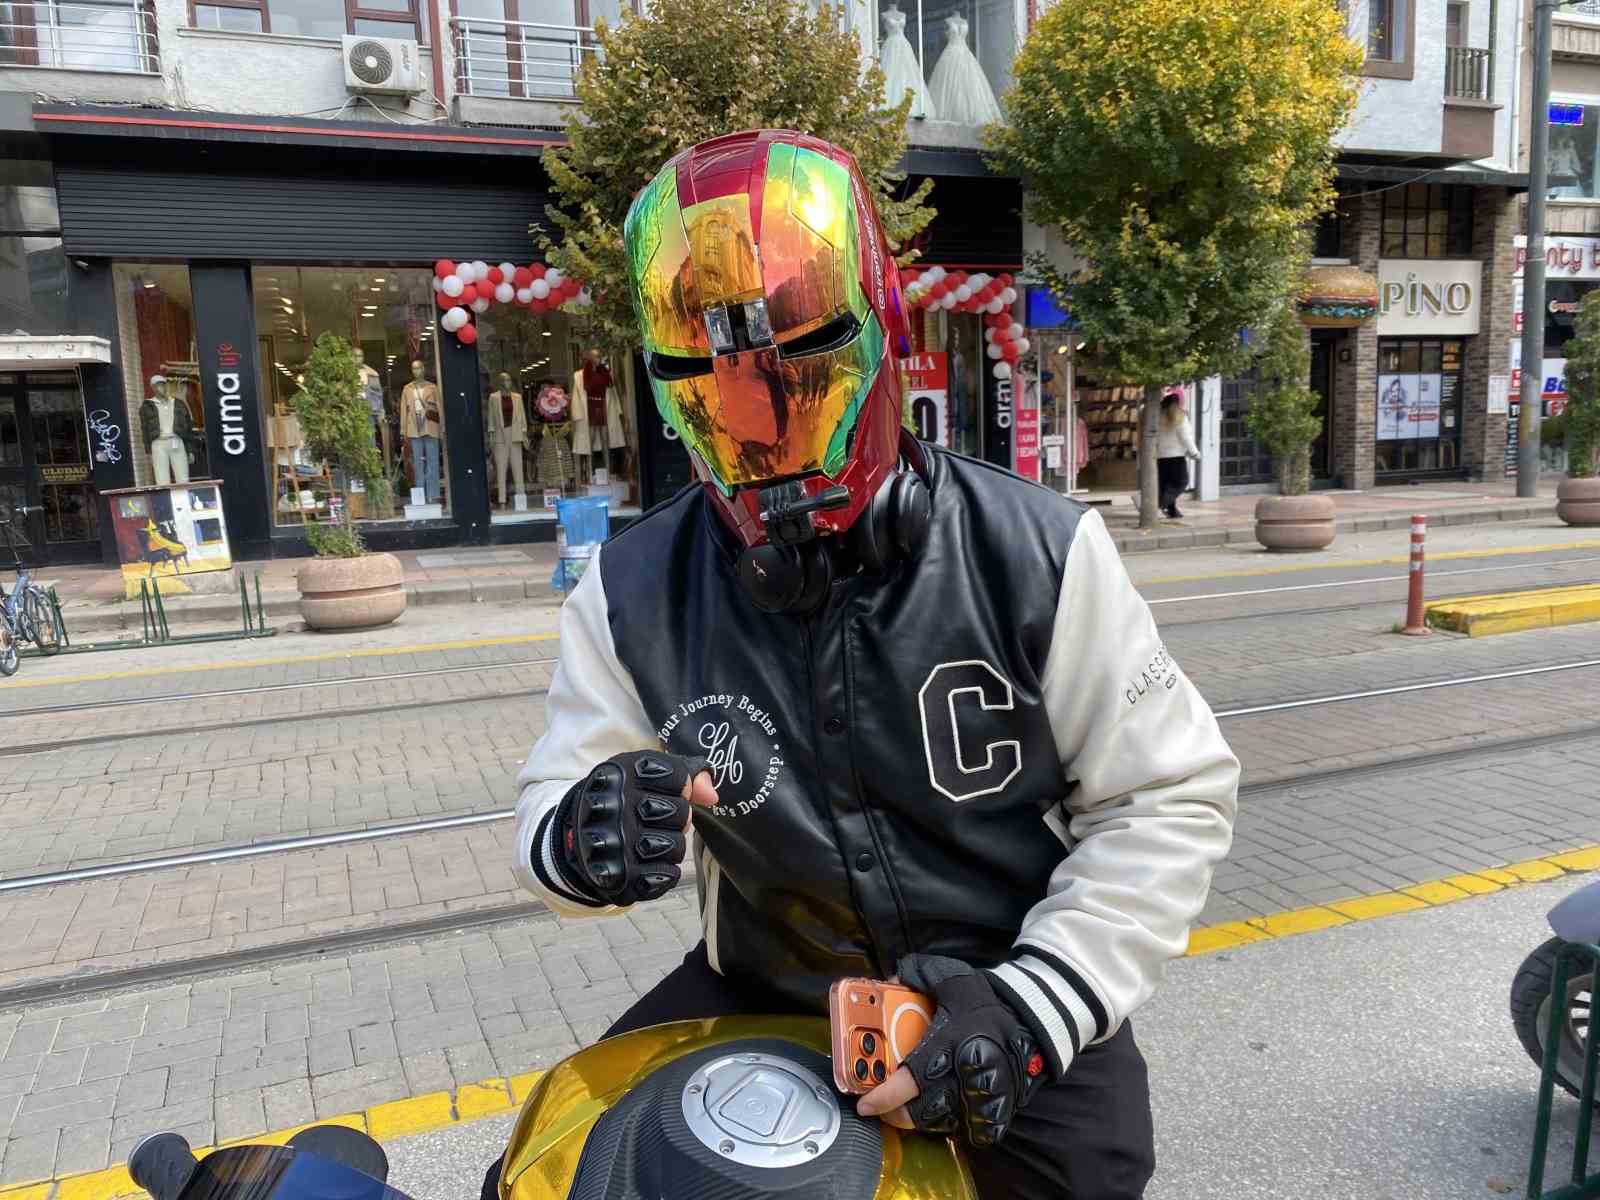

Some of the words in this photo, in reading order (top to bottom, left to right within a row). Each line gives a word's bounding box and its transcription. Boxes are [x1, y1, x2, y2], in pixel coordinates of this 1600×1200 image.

[216, 343, 242, 369] life
[217, 373, 246, 455] arma
[997, 379, 1012, 429] arm
[658, 713, 681, 743] Your
[680, 694, 735, 717] Journey
[737, 695, 777, 736] Begins
[918, 659, 1022, 803] C
[737, 756, 784, 815] Doorstep
